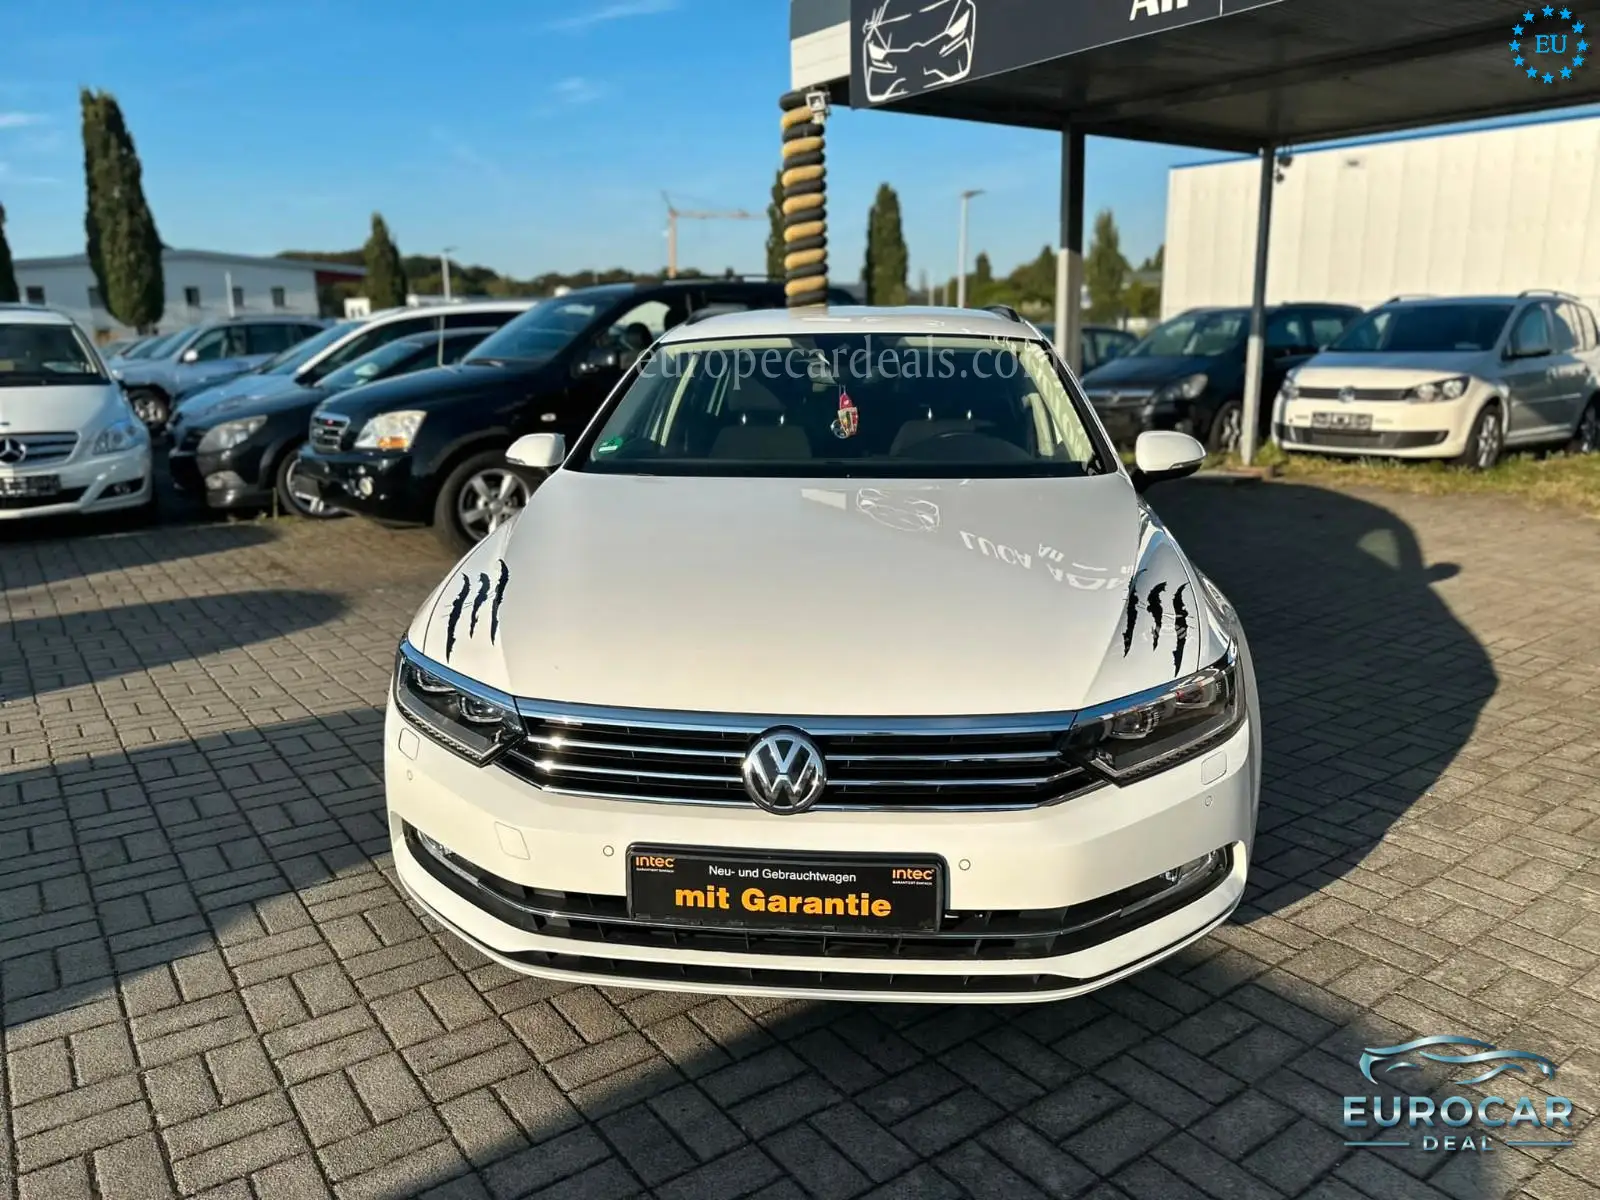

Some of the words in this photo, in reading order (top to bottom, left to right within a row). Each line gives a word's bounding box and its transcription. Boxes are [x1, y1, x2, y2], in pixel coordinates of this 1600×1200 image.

[635, 856, 675, 868] intec
[708, 865, 736, 877] Neu-
[738, 867, 760, 879] und
[762, 870, 857, 884] Gebrauchtwagen
[892, 868, 934, 880] intec
[675, 885, 731, 910] mit
[741, 888, 892, 917] Garantie
